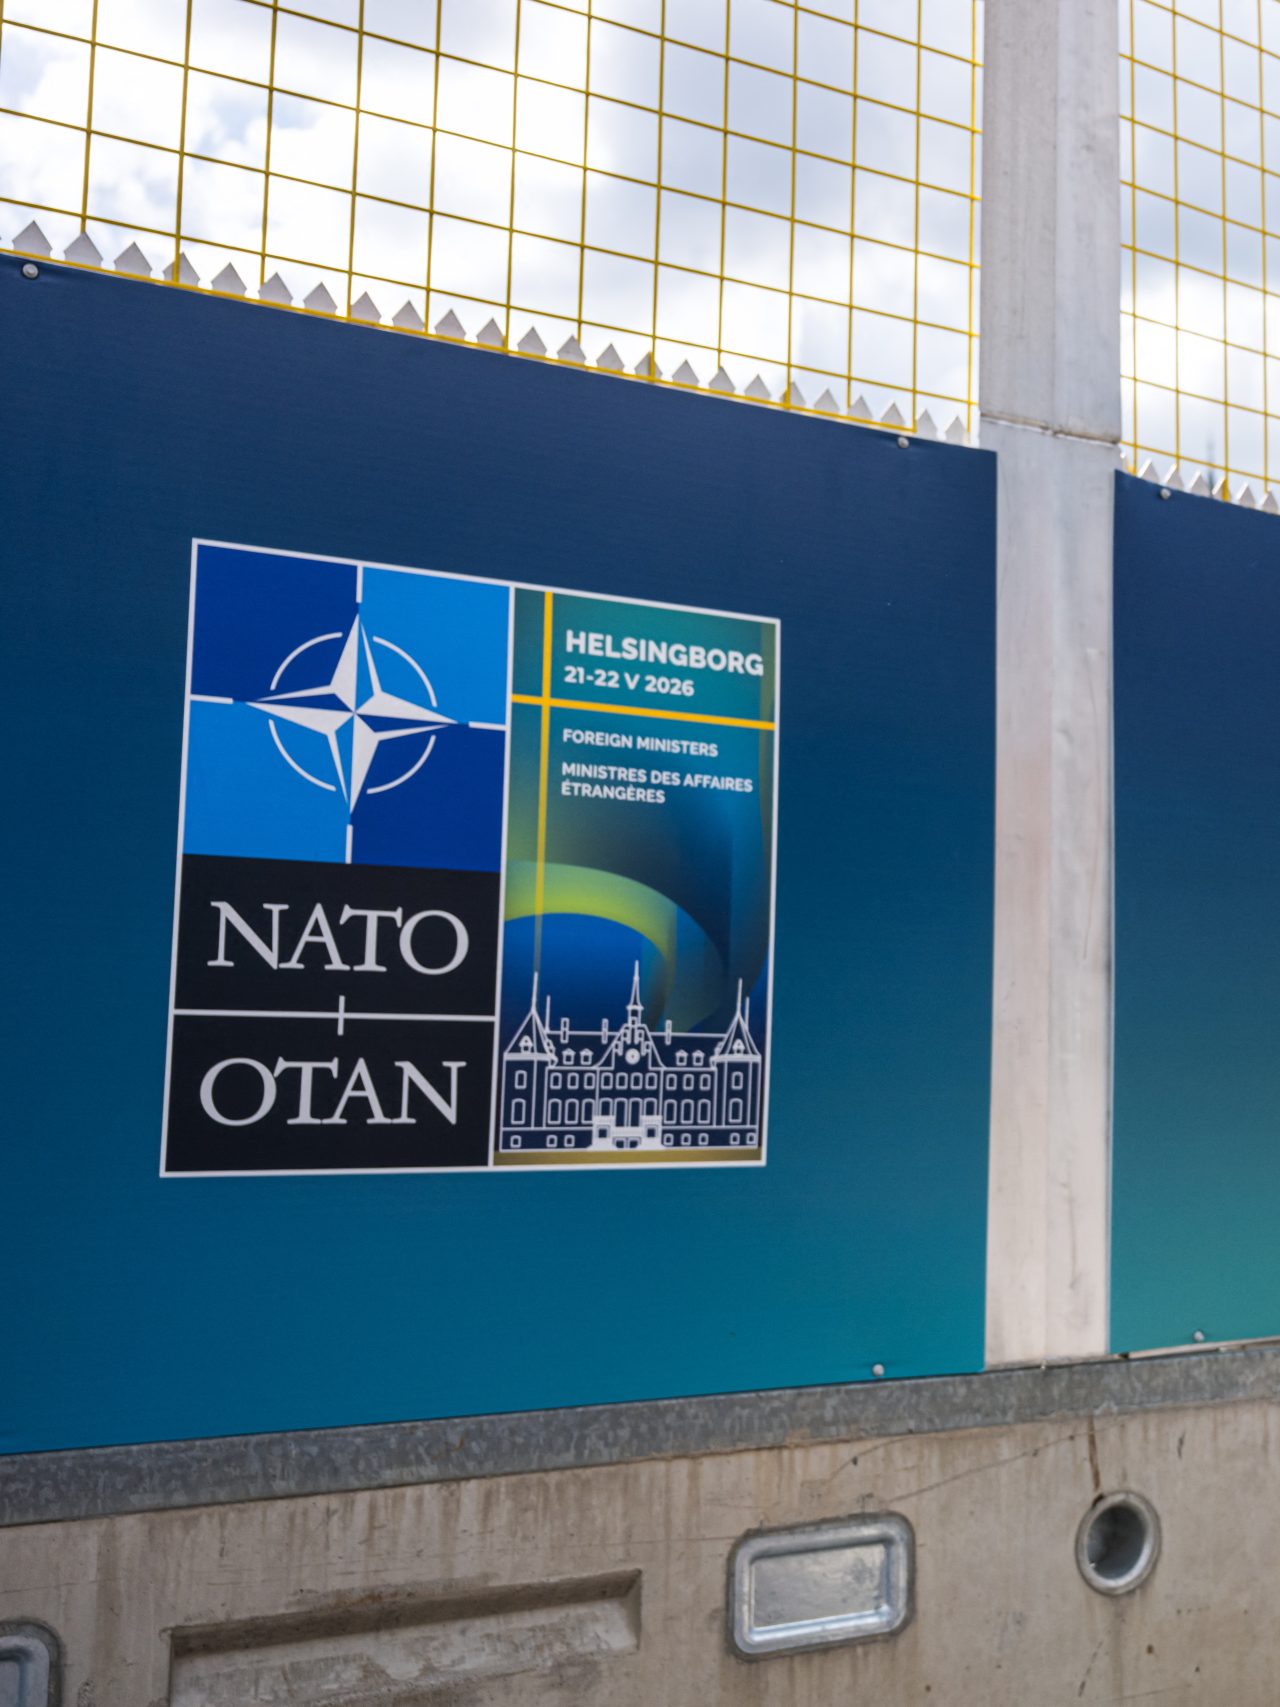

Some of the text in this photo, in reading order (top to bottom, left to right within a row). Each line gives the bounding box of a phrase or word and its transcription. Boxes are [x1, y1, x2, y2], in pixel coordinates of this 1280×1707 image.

[566, 629, 764, 676] HELSINGBORG
[564, 666, 695, 697] 21-22 V 2026
[563, 728, 719, 757] FOREIGN MINISTERS
[561, 778, 666, 804] ÉTRANGÈRES
[562, 762, 753, 793] MINISTRES DES AFFAIRES
[207, 901, 469, 975] NATO
[200, 1056, 467, 1126] OTAN
